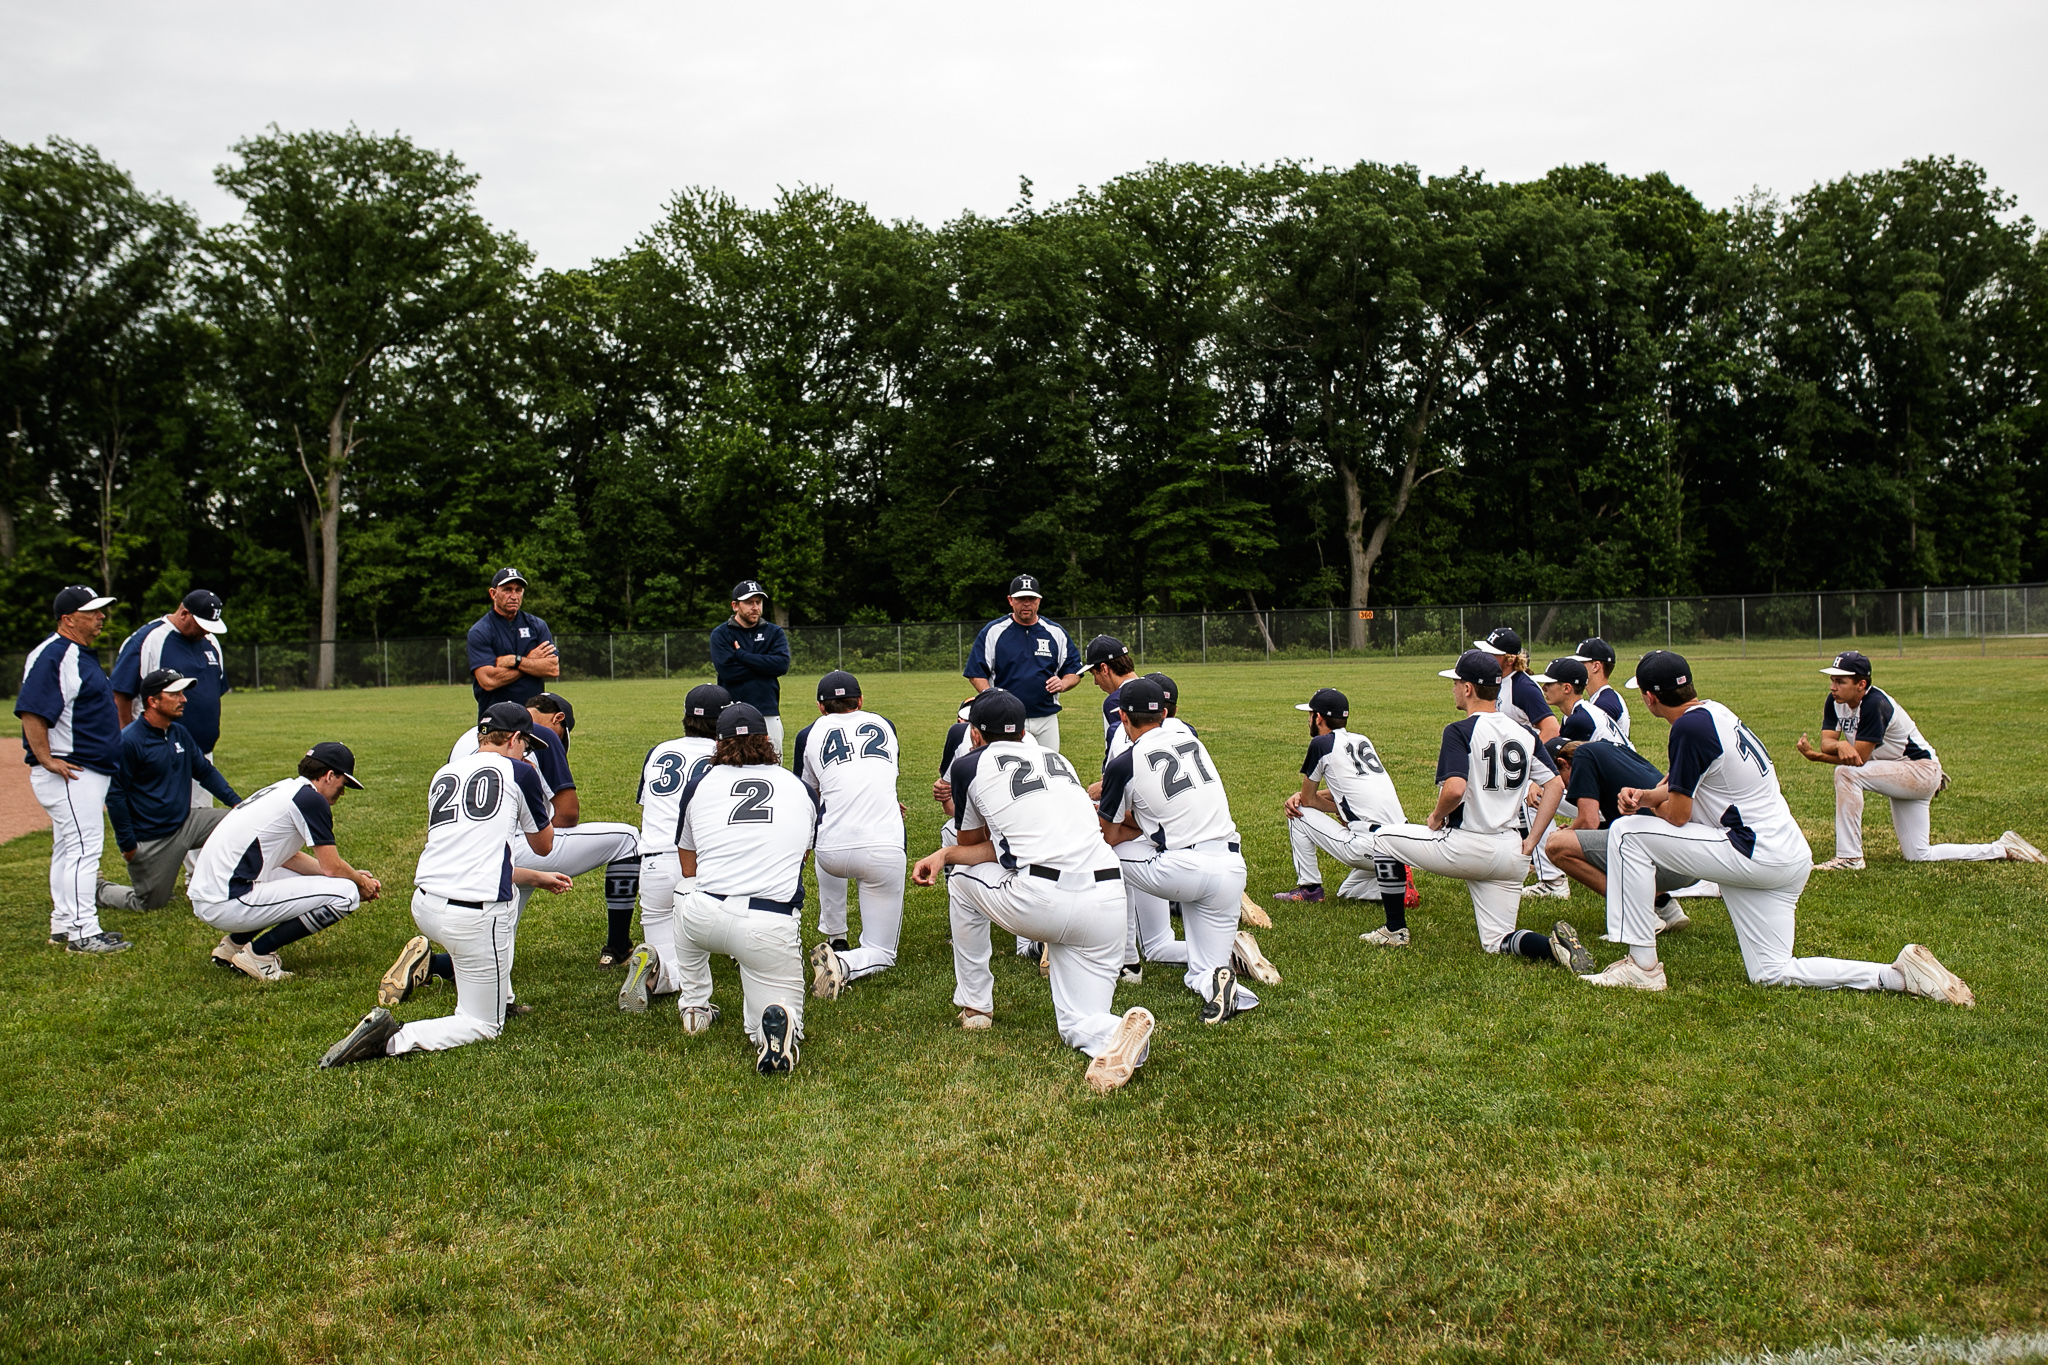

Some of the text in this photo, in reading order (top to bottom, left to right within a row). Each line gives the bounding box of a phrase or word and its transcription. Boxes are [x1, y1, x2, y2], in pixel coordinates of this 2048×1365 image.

[506, 568, 517, 577] H
[747, 583, 758, 592] H
[1021, 579, 1033, 590] H
[211, 609, 222, 620] H
[519, 627, 531, 638] H
[1487, 632, 1499, 645] H
[1036, 638, 1051, 652] H
[204, 650, 217, 662] H
[1832, 656, 1844, 668] H
[820, 722, 893, 769] 42
[1734, 719, 1774, 777] 1
[1344, 740, 1385, 776] 16
[1482, 739, 1530, 791] 19
[994, 752, 1081, 801] 24
[1145, 740, 1215, 801] 27
[428, 766, 503, 833] 20
[728, 778, 774, 825] 2
[1375, 862, 1399, 880] H
[610, 878, 637, 896] H
